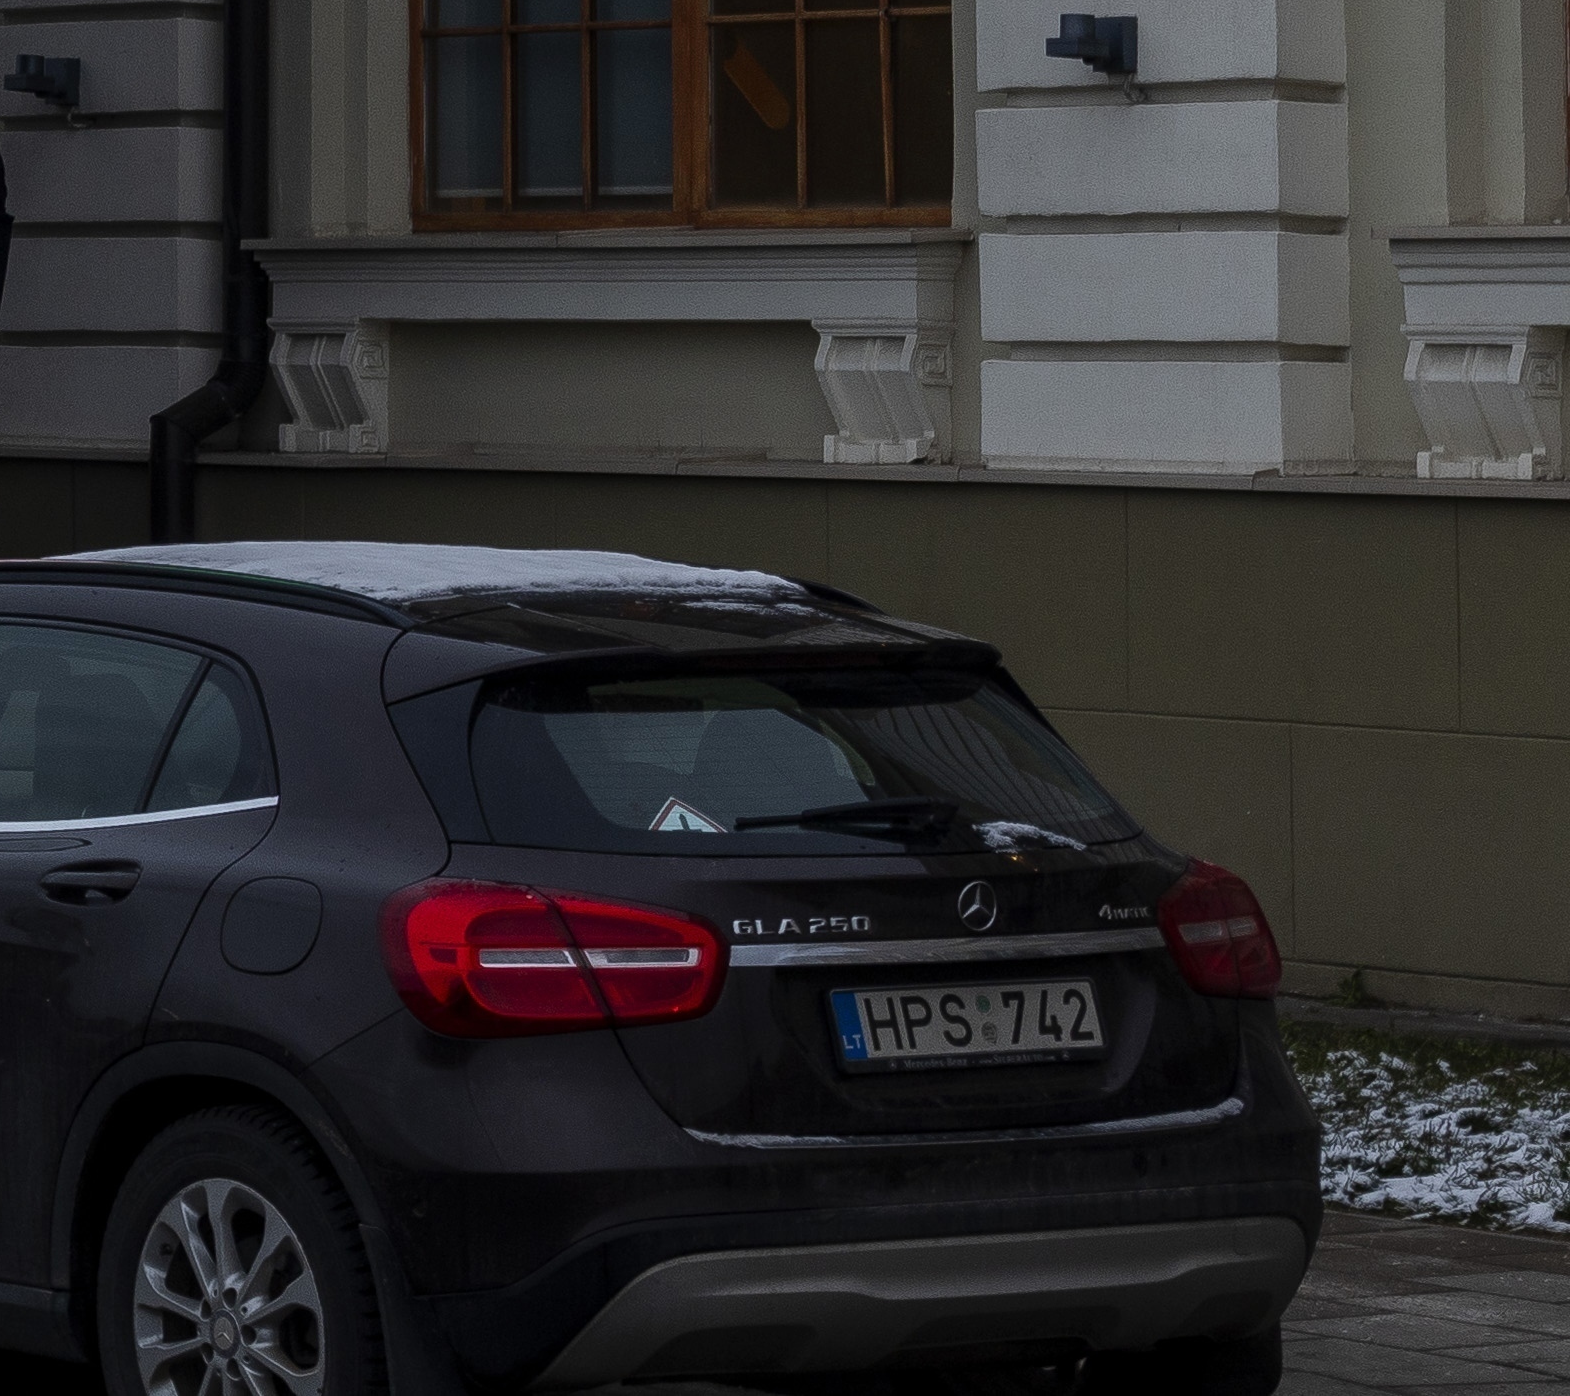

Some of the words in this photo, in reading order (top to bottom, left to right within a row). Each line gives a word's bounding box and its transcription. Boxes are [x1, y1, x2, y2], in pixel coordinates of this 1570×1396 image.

[732, 918, 802, 936] GLA
[807, 914, 871, 934] 250
[843, 1034, 864, 1051] LT
[864, 993, 972, 1052] HPS
[1001, 988, 1095, 1045] 742
